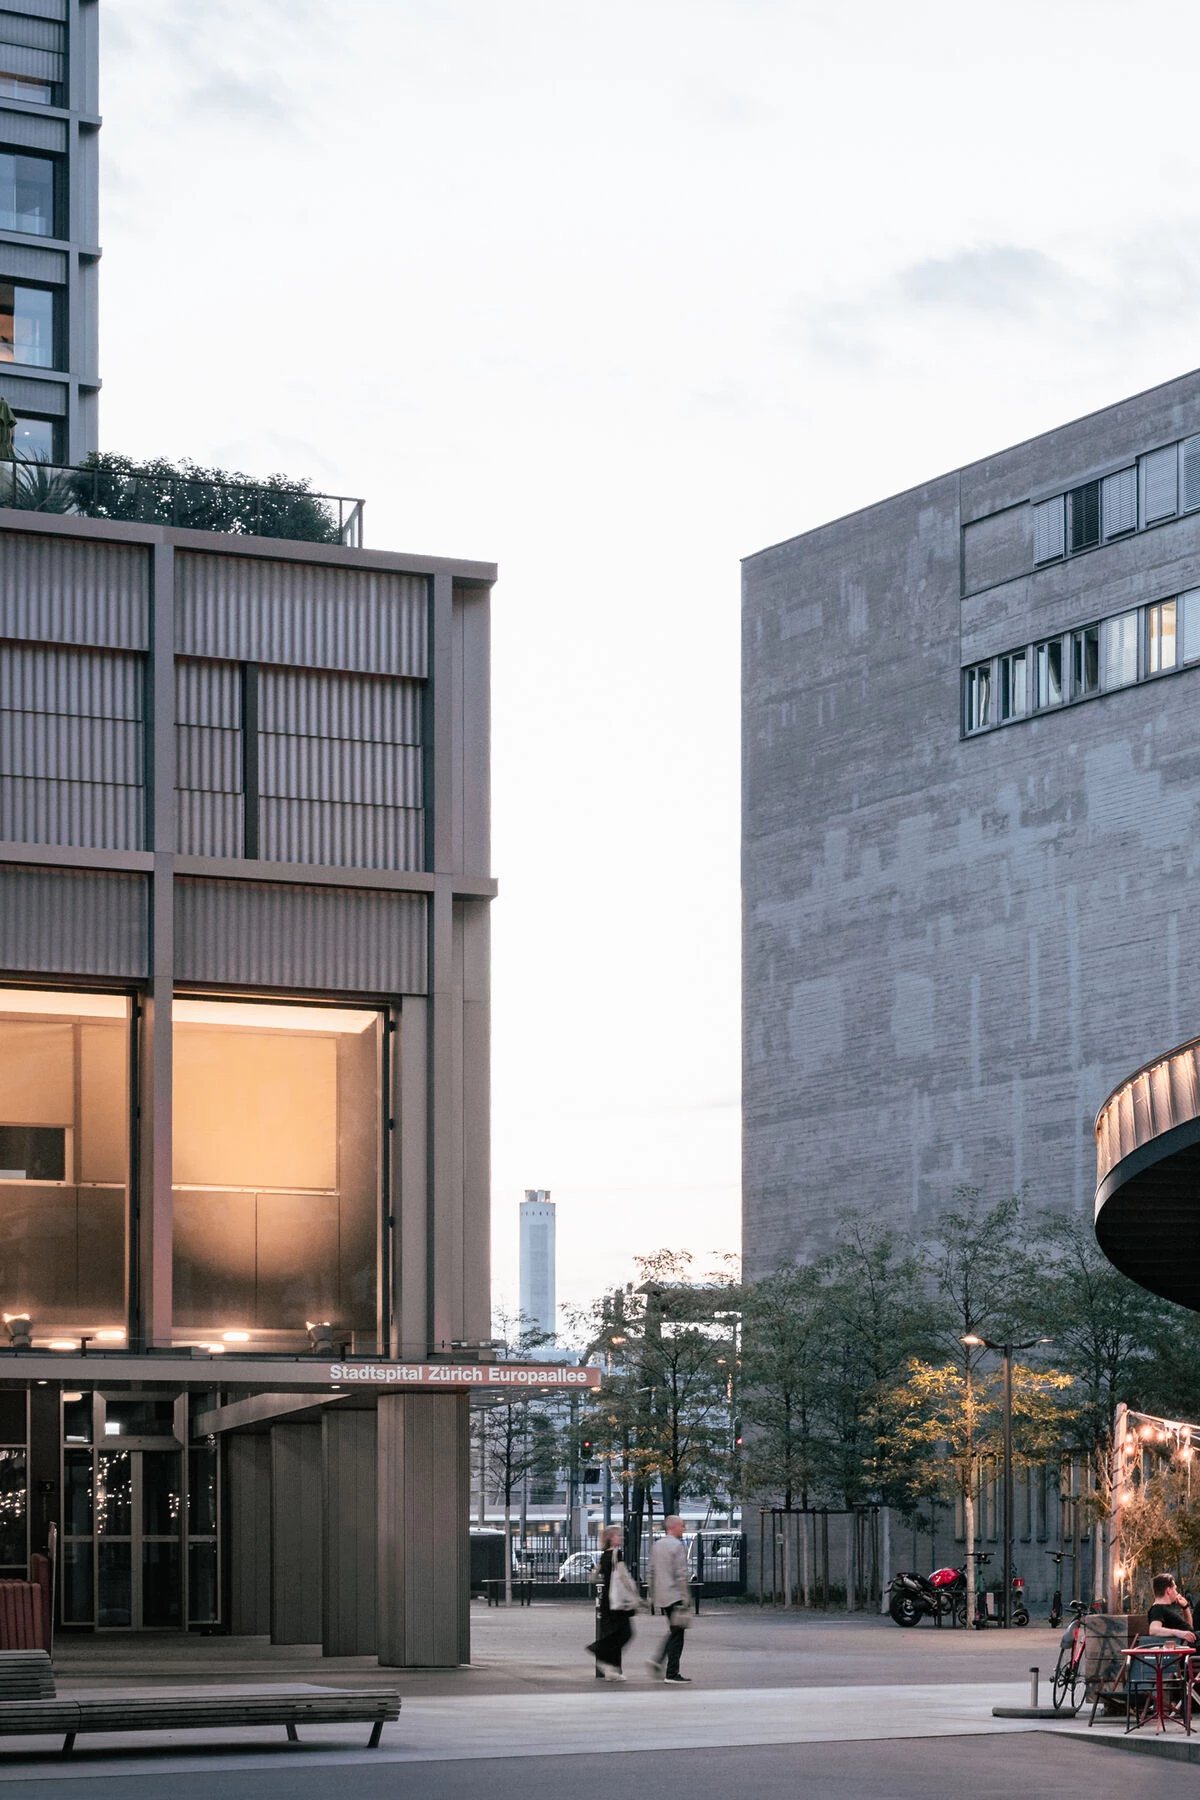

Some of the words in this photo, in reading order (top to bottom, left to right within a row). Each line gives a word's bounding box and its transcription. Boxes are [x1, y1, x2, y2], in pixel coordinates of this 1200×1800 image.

[330, 1365, 422, 1383] Stadtspital
[429, 1366, 483, 1382] Zürich
[488, 1368, 587, 1384] Europaallee
